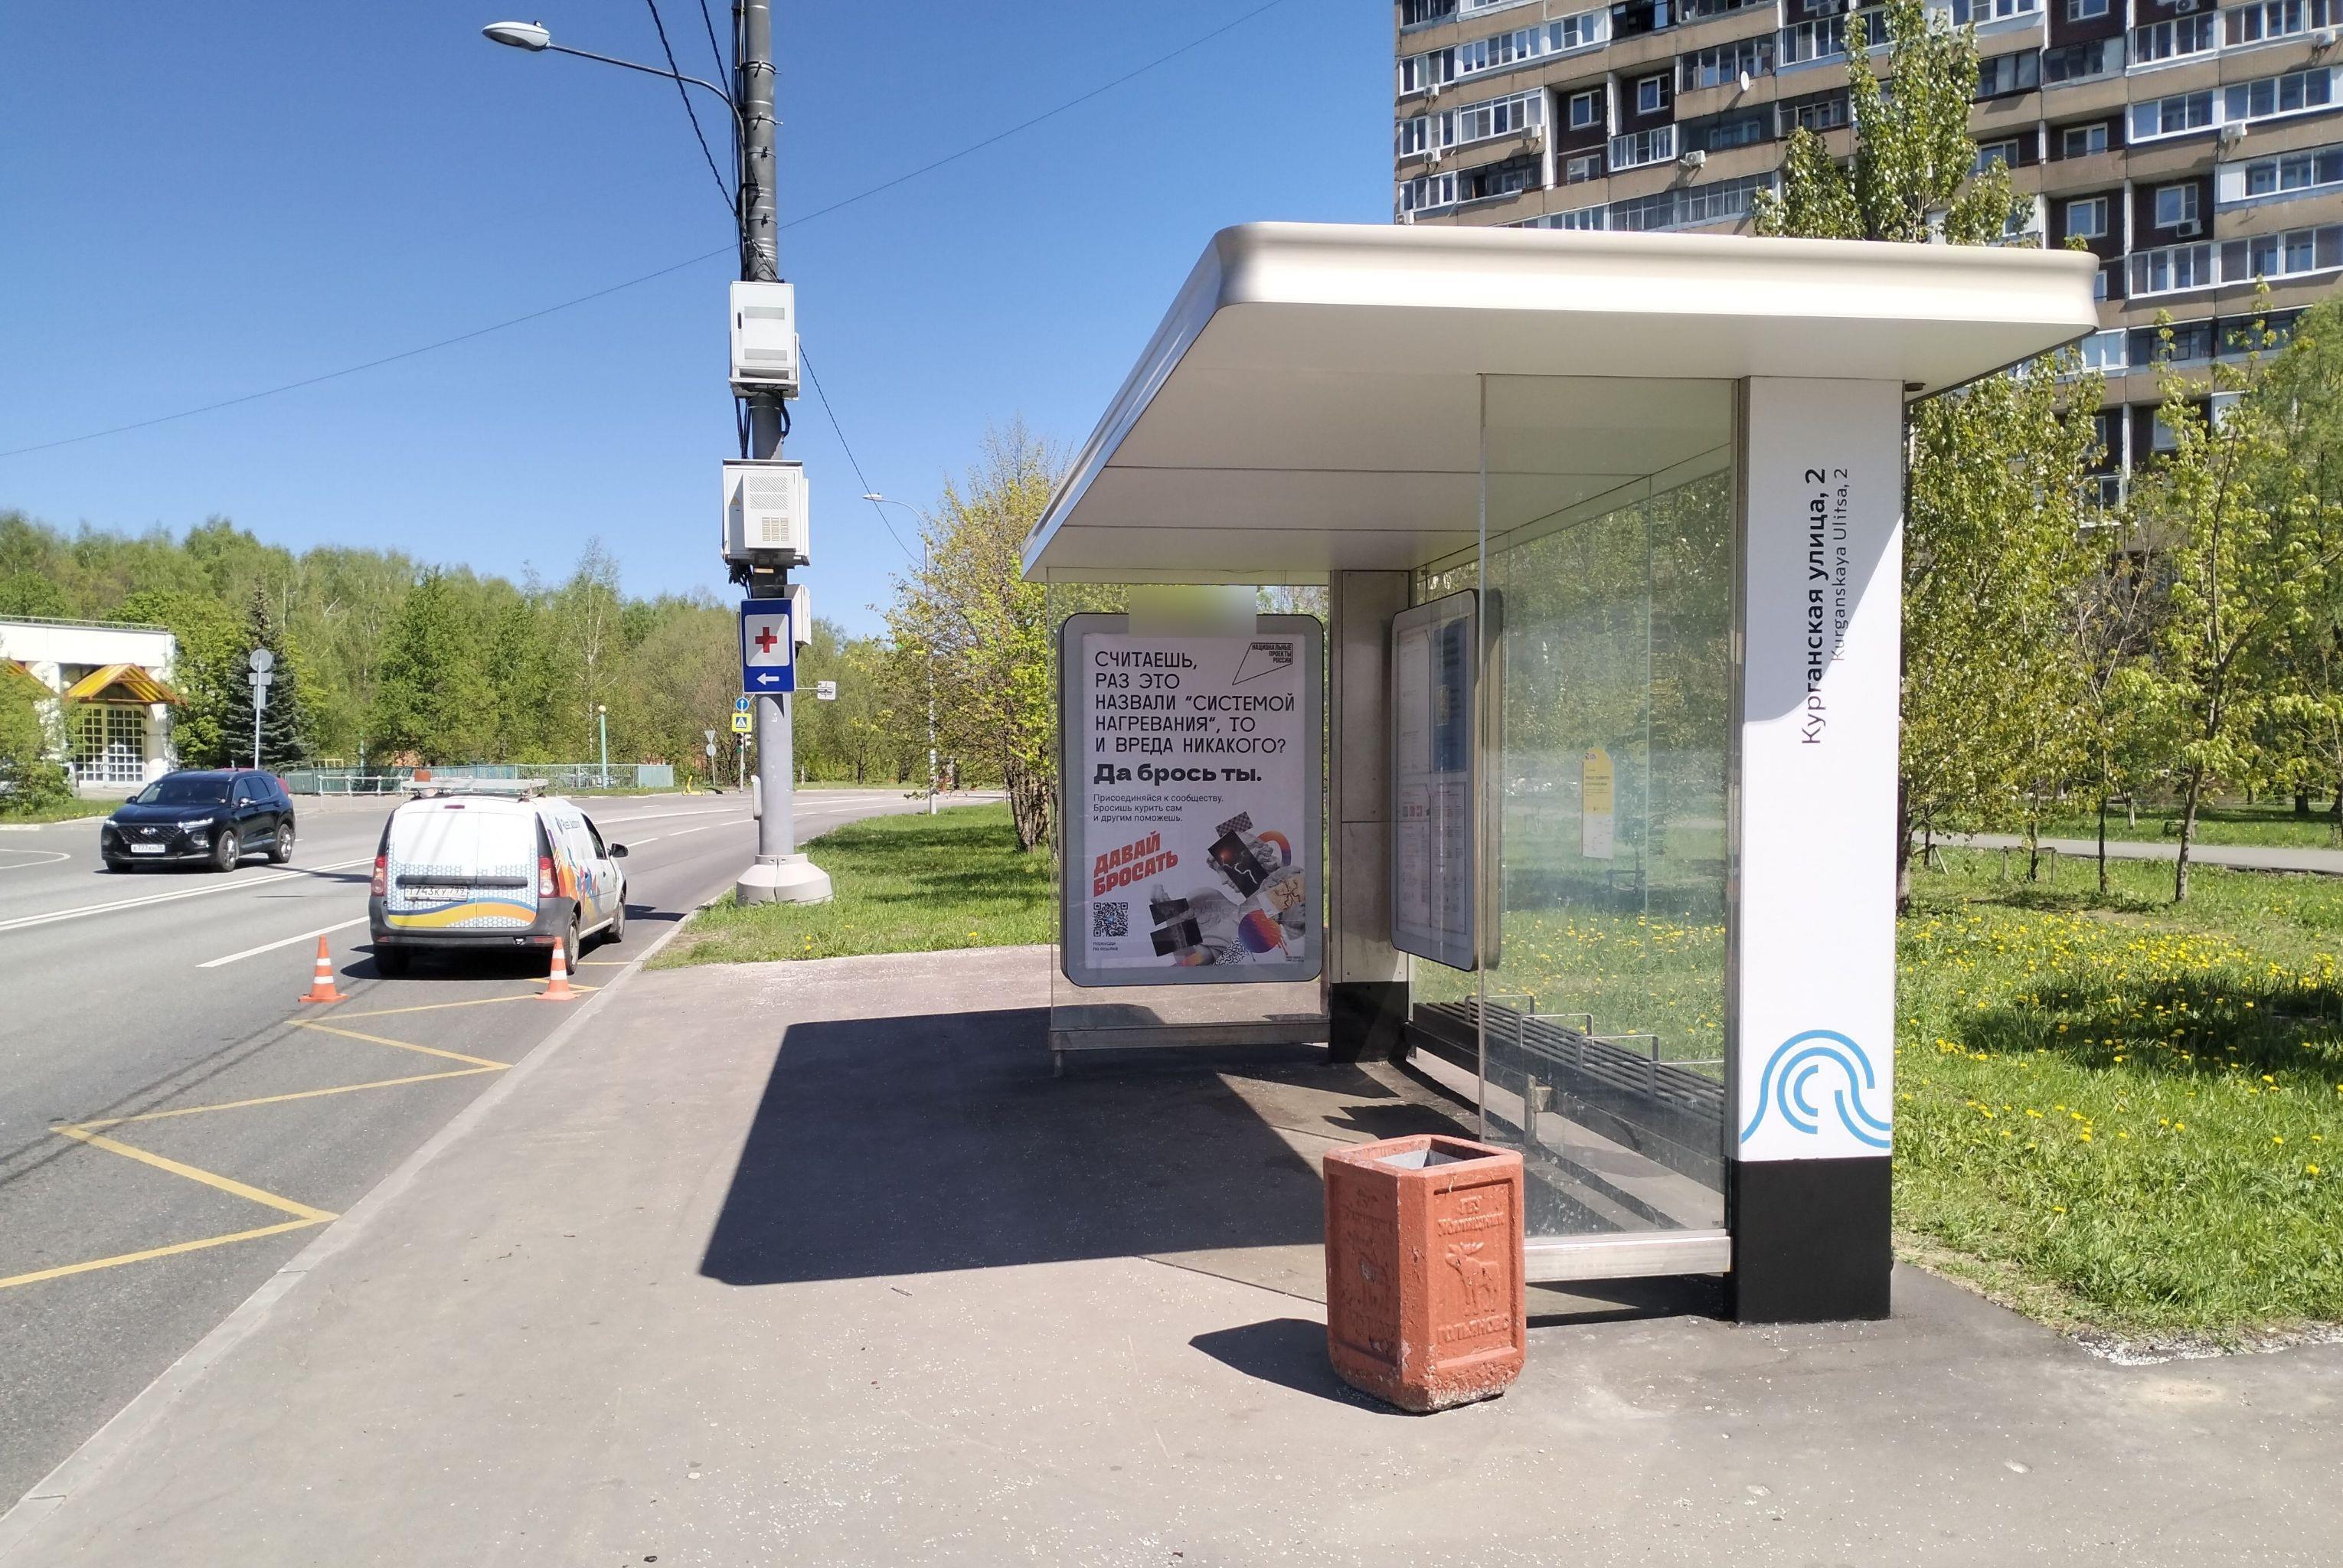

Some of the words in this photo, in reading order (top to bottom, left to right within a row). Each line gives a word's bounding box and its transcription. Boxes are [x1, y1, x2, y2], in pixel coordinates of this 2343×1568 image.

[1805, 467, 1826, 484] 2
[1834, 468, 1848, 479] 2
[1832, 484, 1850, 541] Ulitsa,
[1808, 492, 1829, 581] улица,
[1831, 546, 1850, 661] Kurganskaya
[1095, 651, 1198, 670] СЧИТАЕШЬ,
[1801, 589, 1827, 744] Курганская
[1095, 673, 1129, 689] РАЗ
[1139, 673, 1180, 689] ЭТО
[1095, 694, 1176, 710] НАЗВАЛИ
[1230, 717, 1256, 732] ТО
[1095, 737, 1105, 753] И
[1116, 737, 1174, 755] ВРЕДА
[1183, 738, 1286, 753] НИКАКОГО?
[1093, 763, 1132, 785] Да
[1137, 763, 1217, 786] брось
[1221, 767, 1262, 782] ты.
[1093, 793, 1162, 802] Присоединяйся
[1171, 793, 1224, 803] сообществу.
[1093, 804, 1132, 812] Бросишь
[1134, 805, 1164, 813] курить
[1100, 815, 1132, 823] другим
[1093, 831, 1161, 878] ДАВАЙ
[1093, 850, 1179, 897] БРОСАТЬ
